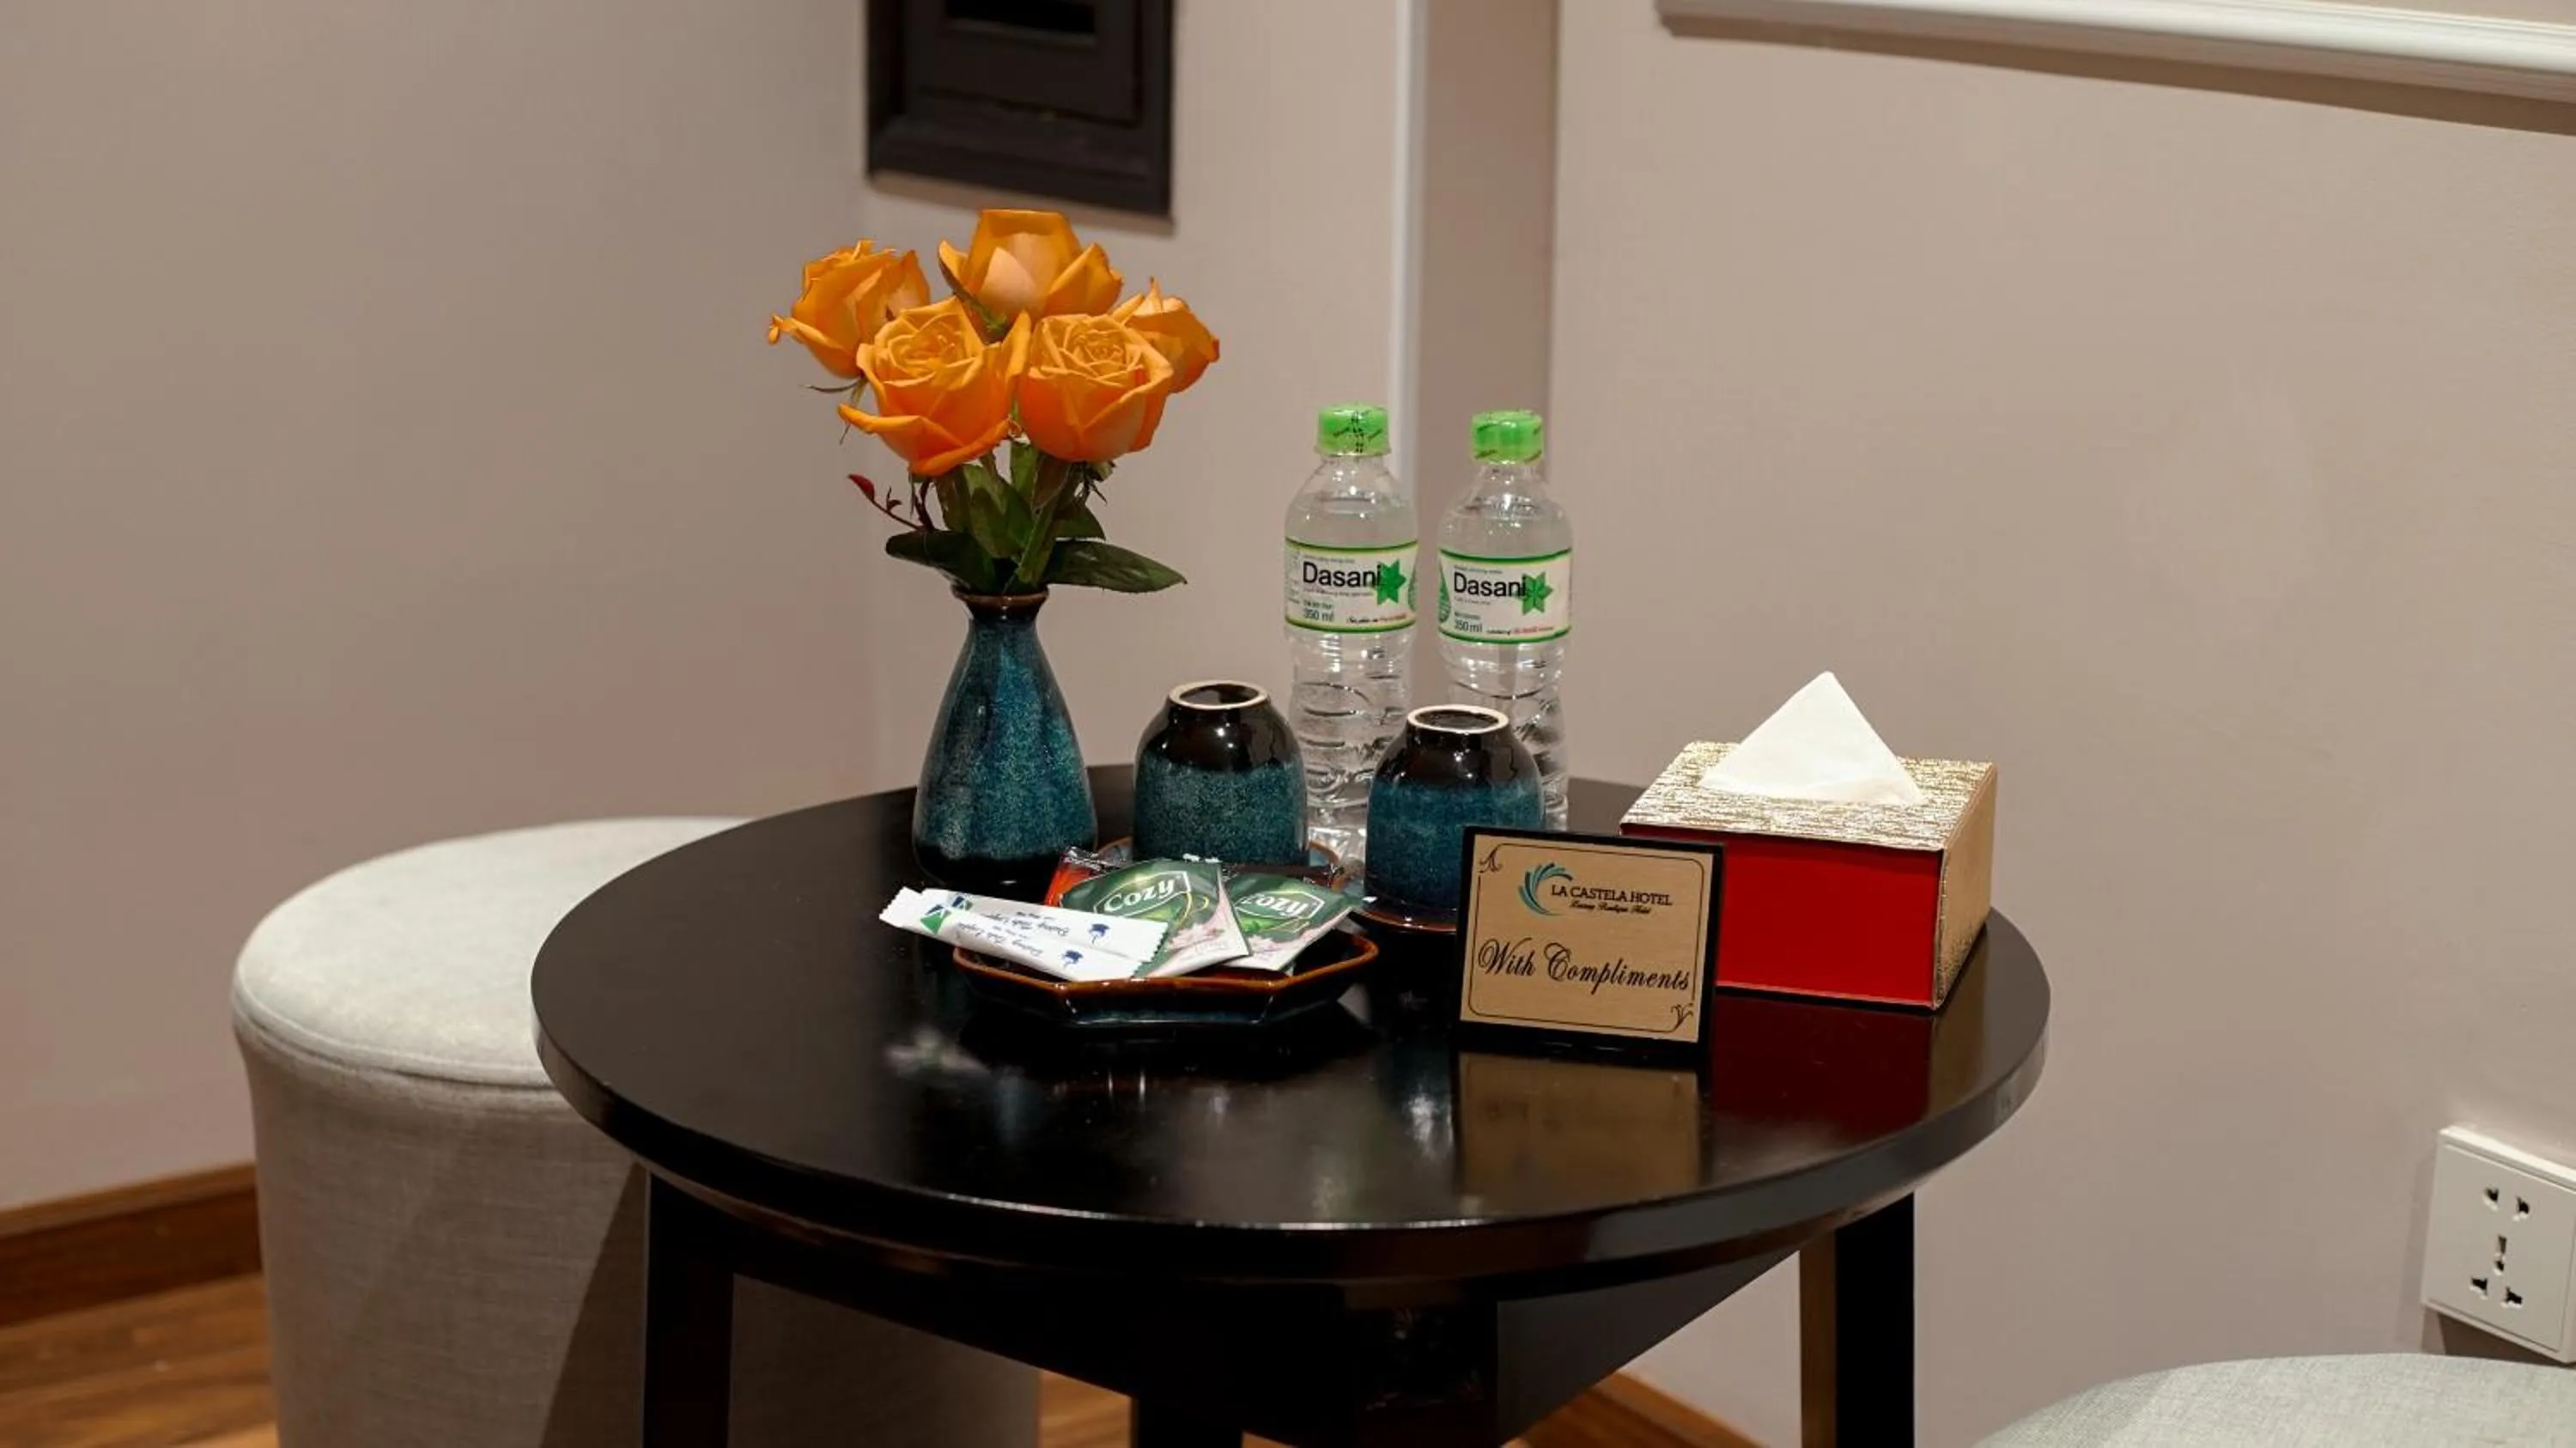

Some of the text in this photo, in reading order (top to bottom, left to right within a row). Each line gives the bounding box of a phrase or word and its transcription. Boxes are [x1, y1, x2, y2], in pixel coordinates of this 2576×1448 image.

[1303, 561, 1382, 588] Dasani
[1454, 571, 1526, 597] Dasani
[1104, 879, 1175, 912] Cozy
[1551, 884, 1674, 906] LA CASTELA HOTEL
[1478, 937, 1691, 995] With Compliments
